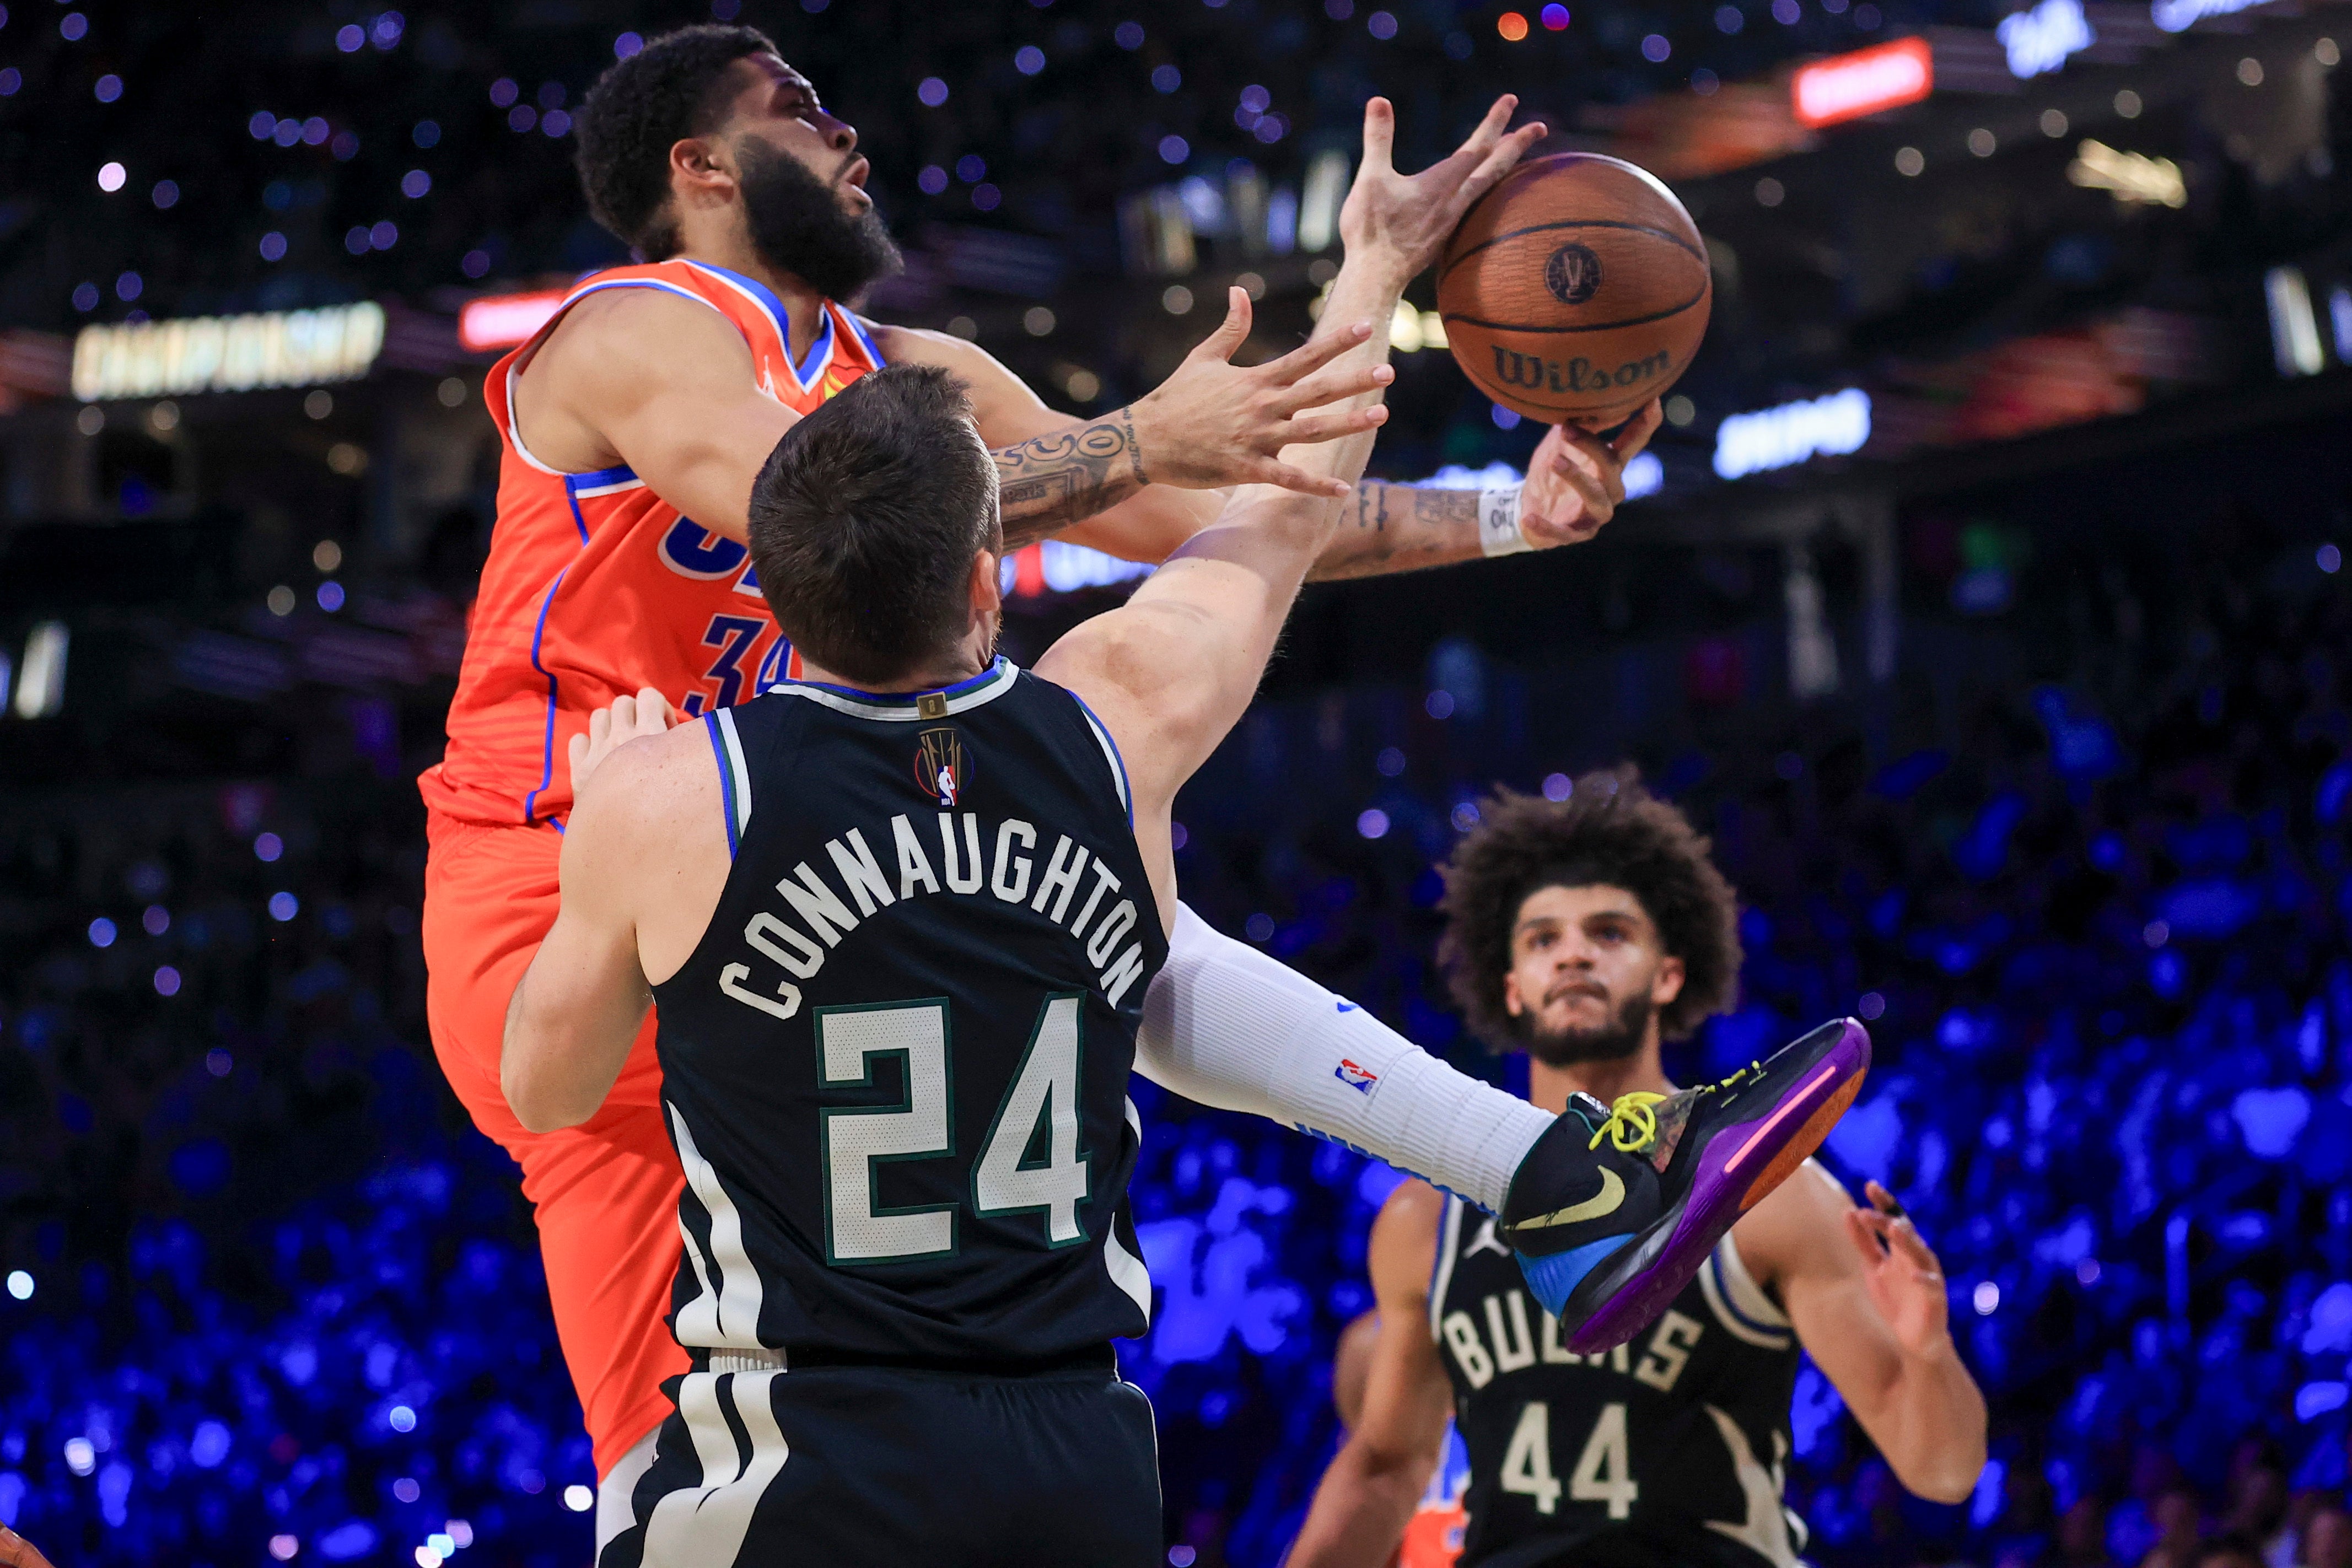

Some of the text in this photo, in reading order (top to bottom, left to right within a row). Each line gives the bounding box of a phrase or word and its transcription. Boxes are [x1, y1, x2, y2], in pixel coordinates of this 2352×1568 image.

[1490, 344, 1671, 394] Wilson
[681, 612, 794, 718] 34
[718, 811, 1144, 1020] CONNAUGHTON
[813, 990, 1092, 1267] 24
[1442, 1289, 1705, 1393] BUS
[1500, 1402, 1640, 1521] 44
